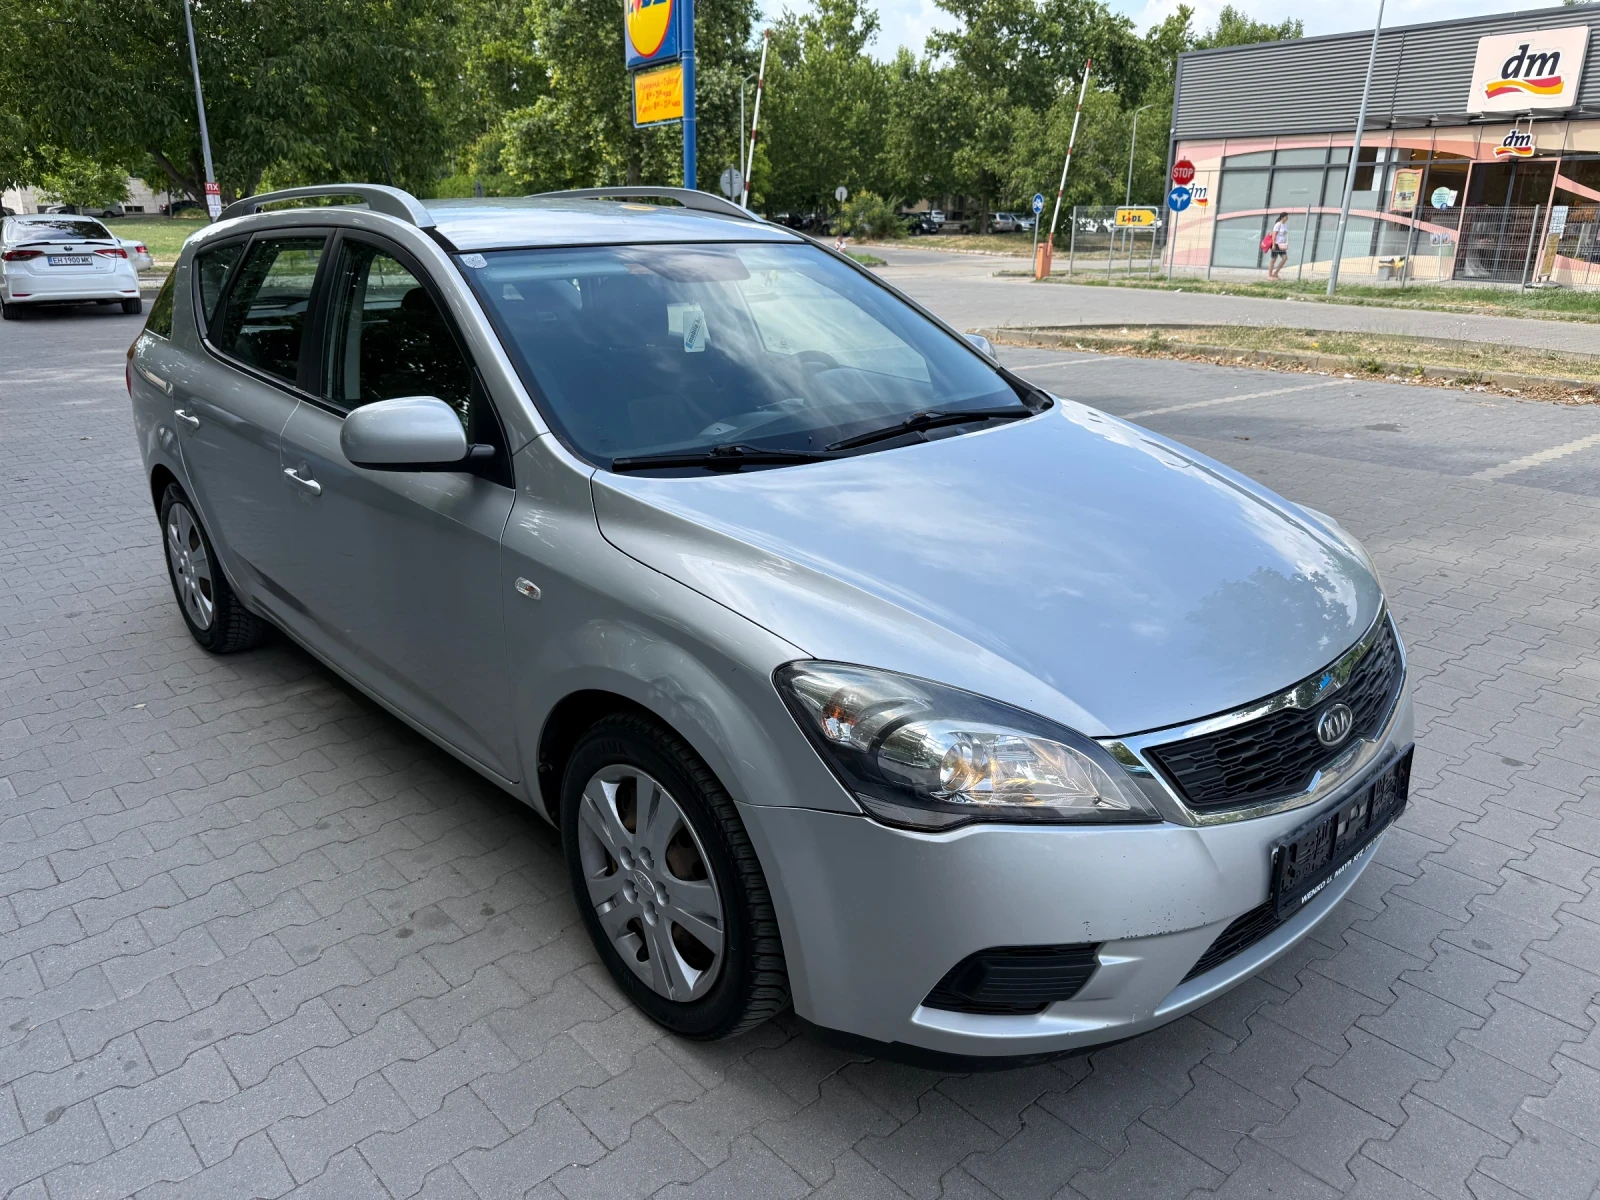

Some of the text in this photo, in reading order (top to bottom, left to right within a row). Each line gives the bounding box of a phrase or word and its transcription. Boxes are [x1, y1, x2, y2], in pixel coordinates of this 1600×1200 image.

[1501, 44, 1560, 79] dm
[1503, 131, 1531, 147] dm
[1174, 168, 1193, 178] STOP
[52, 256, 63, 264] EH
[1324, 711, 1349, 740] KIA
